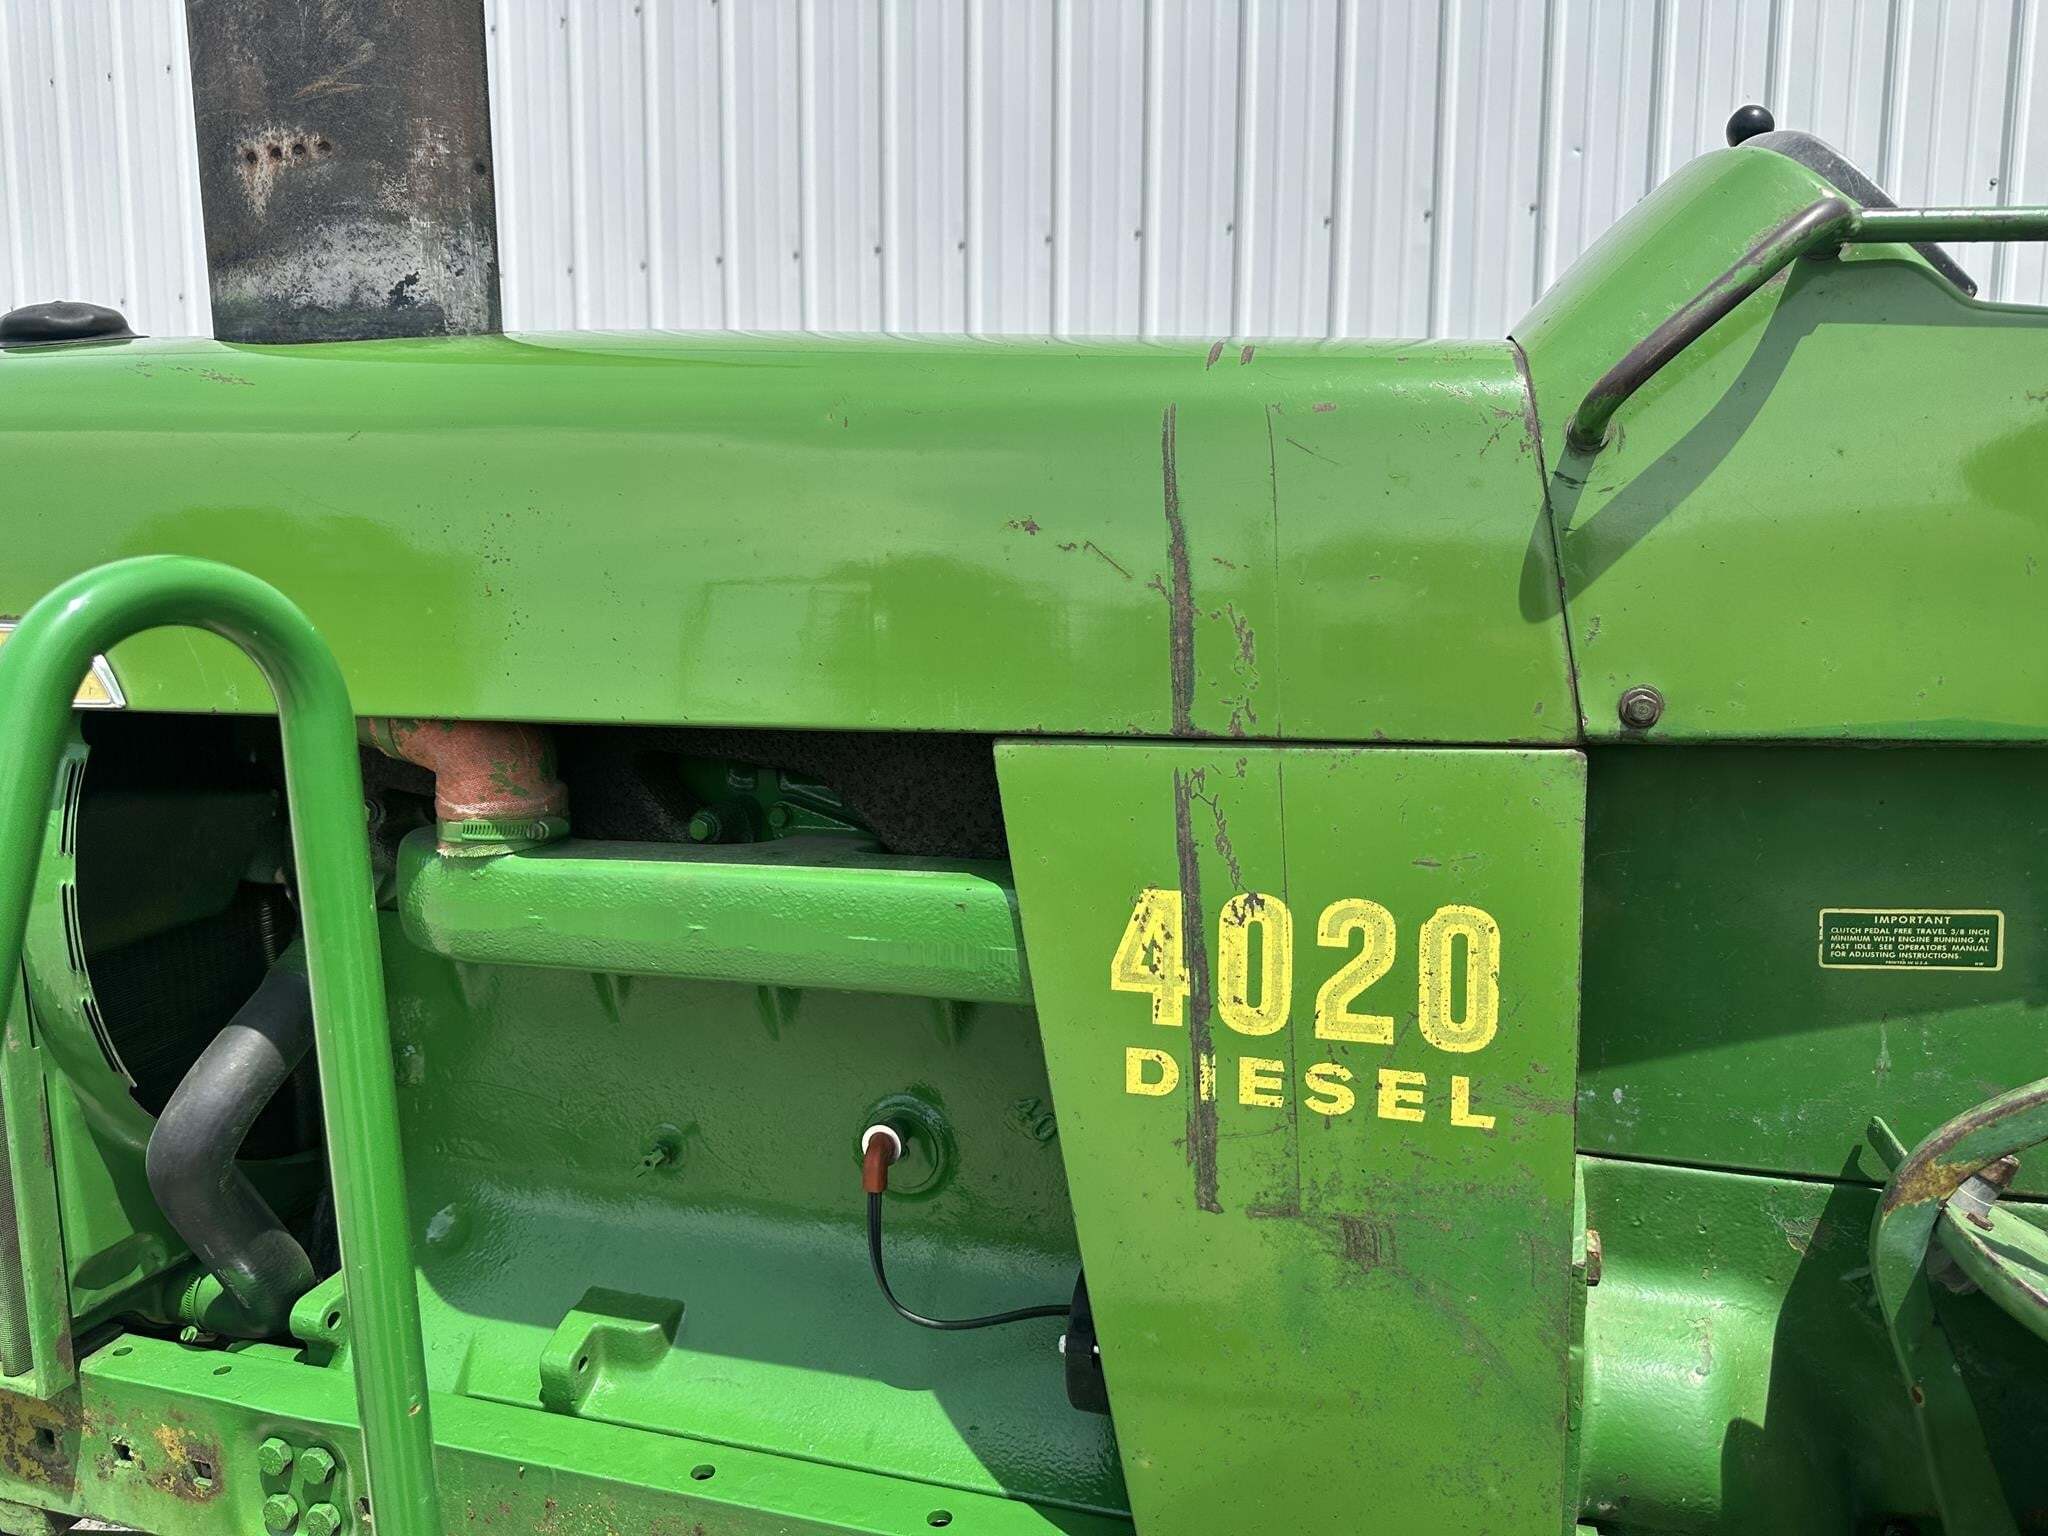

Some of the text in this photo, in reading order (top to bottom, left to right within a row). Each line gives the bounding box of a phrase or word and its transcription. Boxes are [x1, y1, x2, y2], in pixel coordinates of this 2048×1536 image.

[1874, 915, 1951, 924] IMPORTANT
[1950, 928, 1965, 936] 3/8
[1110, 888, 1501, 1053] 4020
[1125, 1047, 1497, 1130] DIESEL
